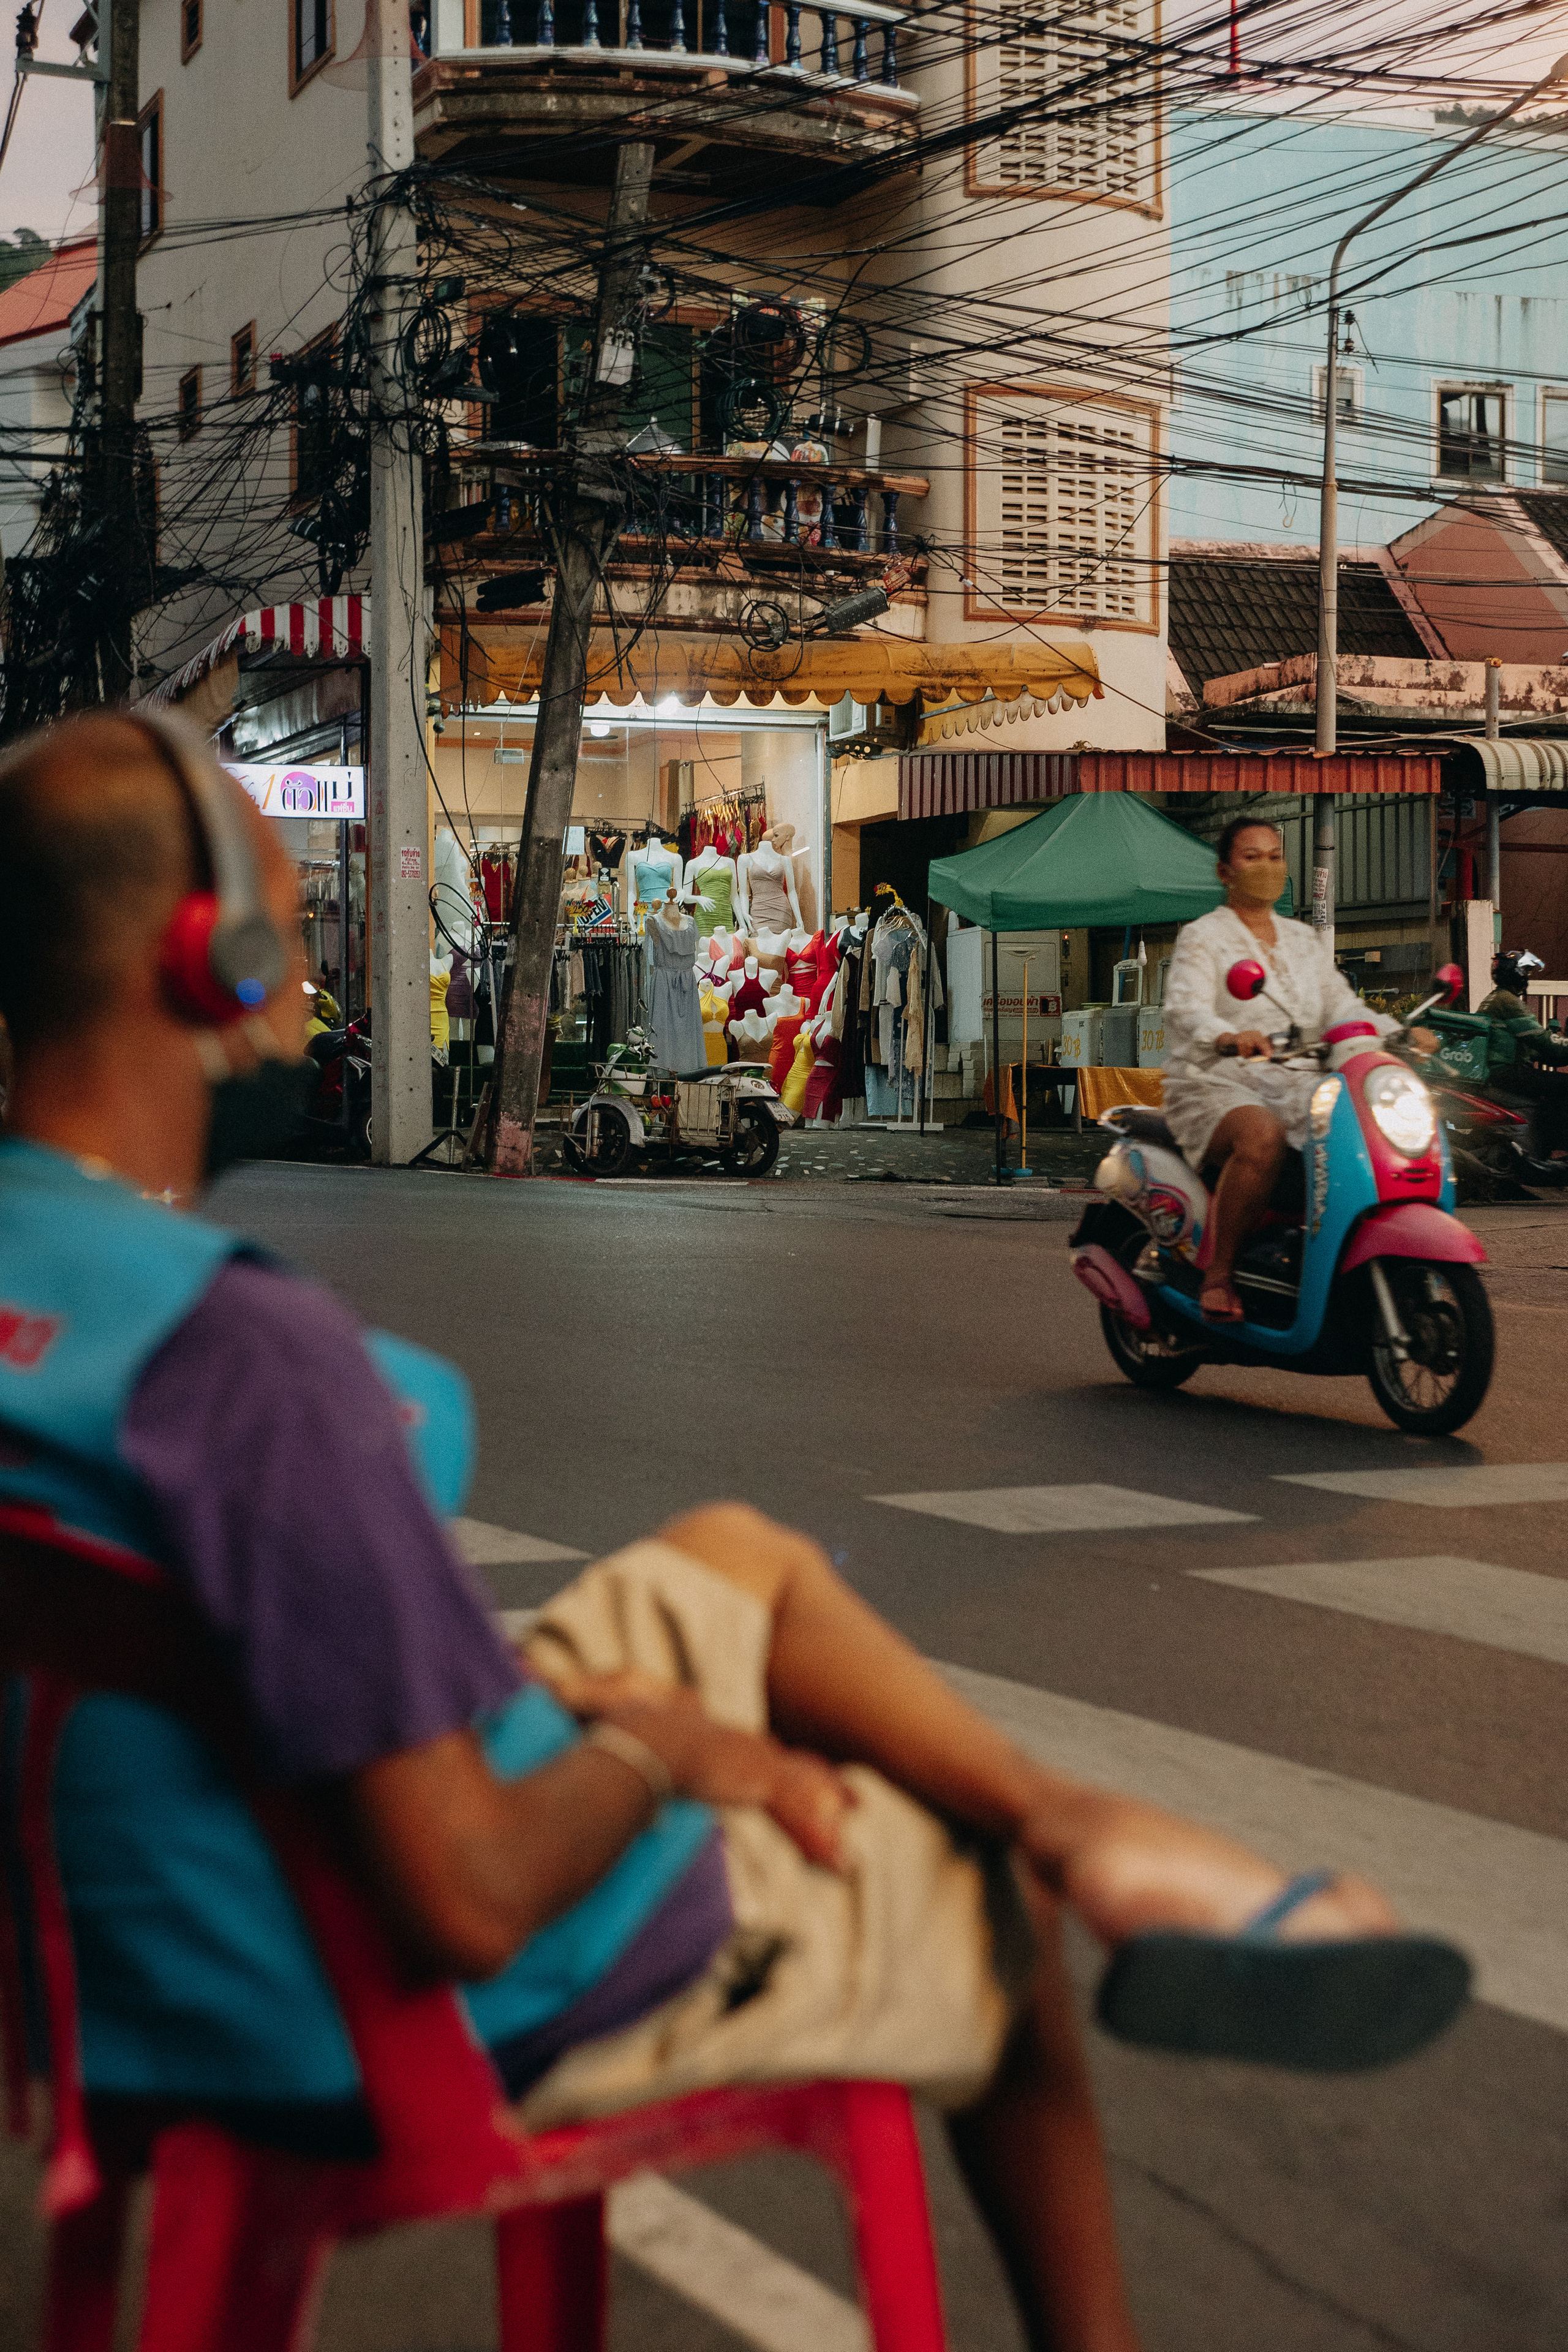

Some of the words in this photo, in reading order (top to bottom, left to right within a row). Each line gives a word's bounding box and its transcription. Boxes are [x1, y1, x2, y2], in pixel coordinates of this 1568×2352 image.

[281, 771, 352, 812] ตัวแม่
[1440, 1047, 1474, 1063] Grab
